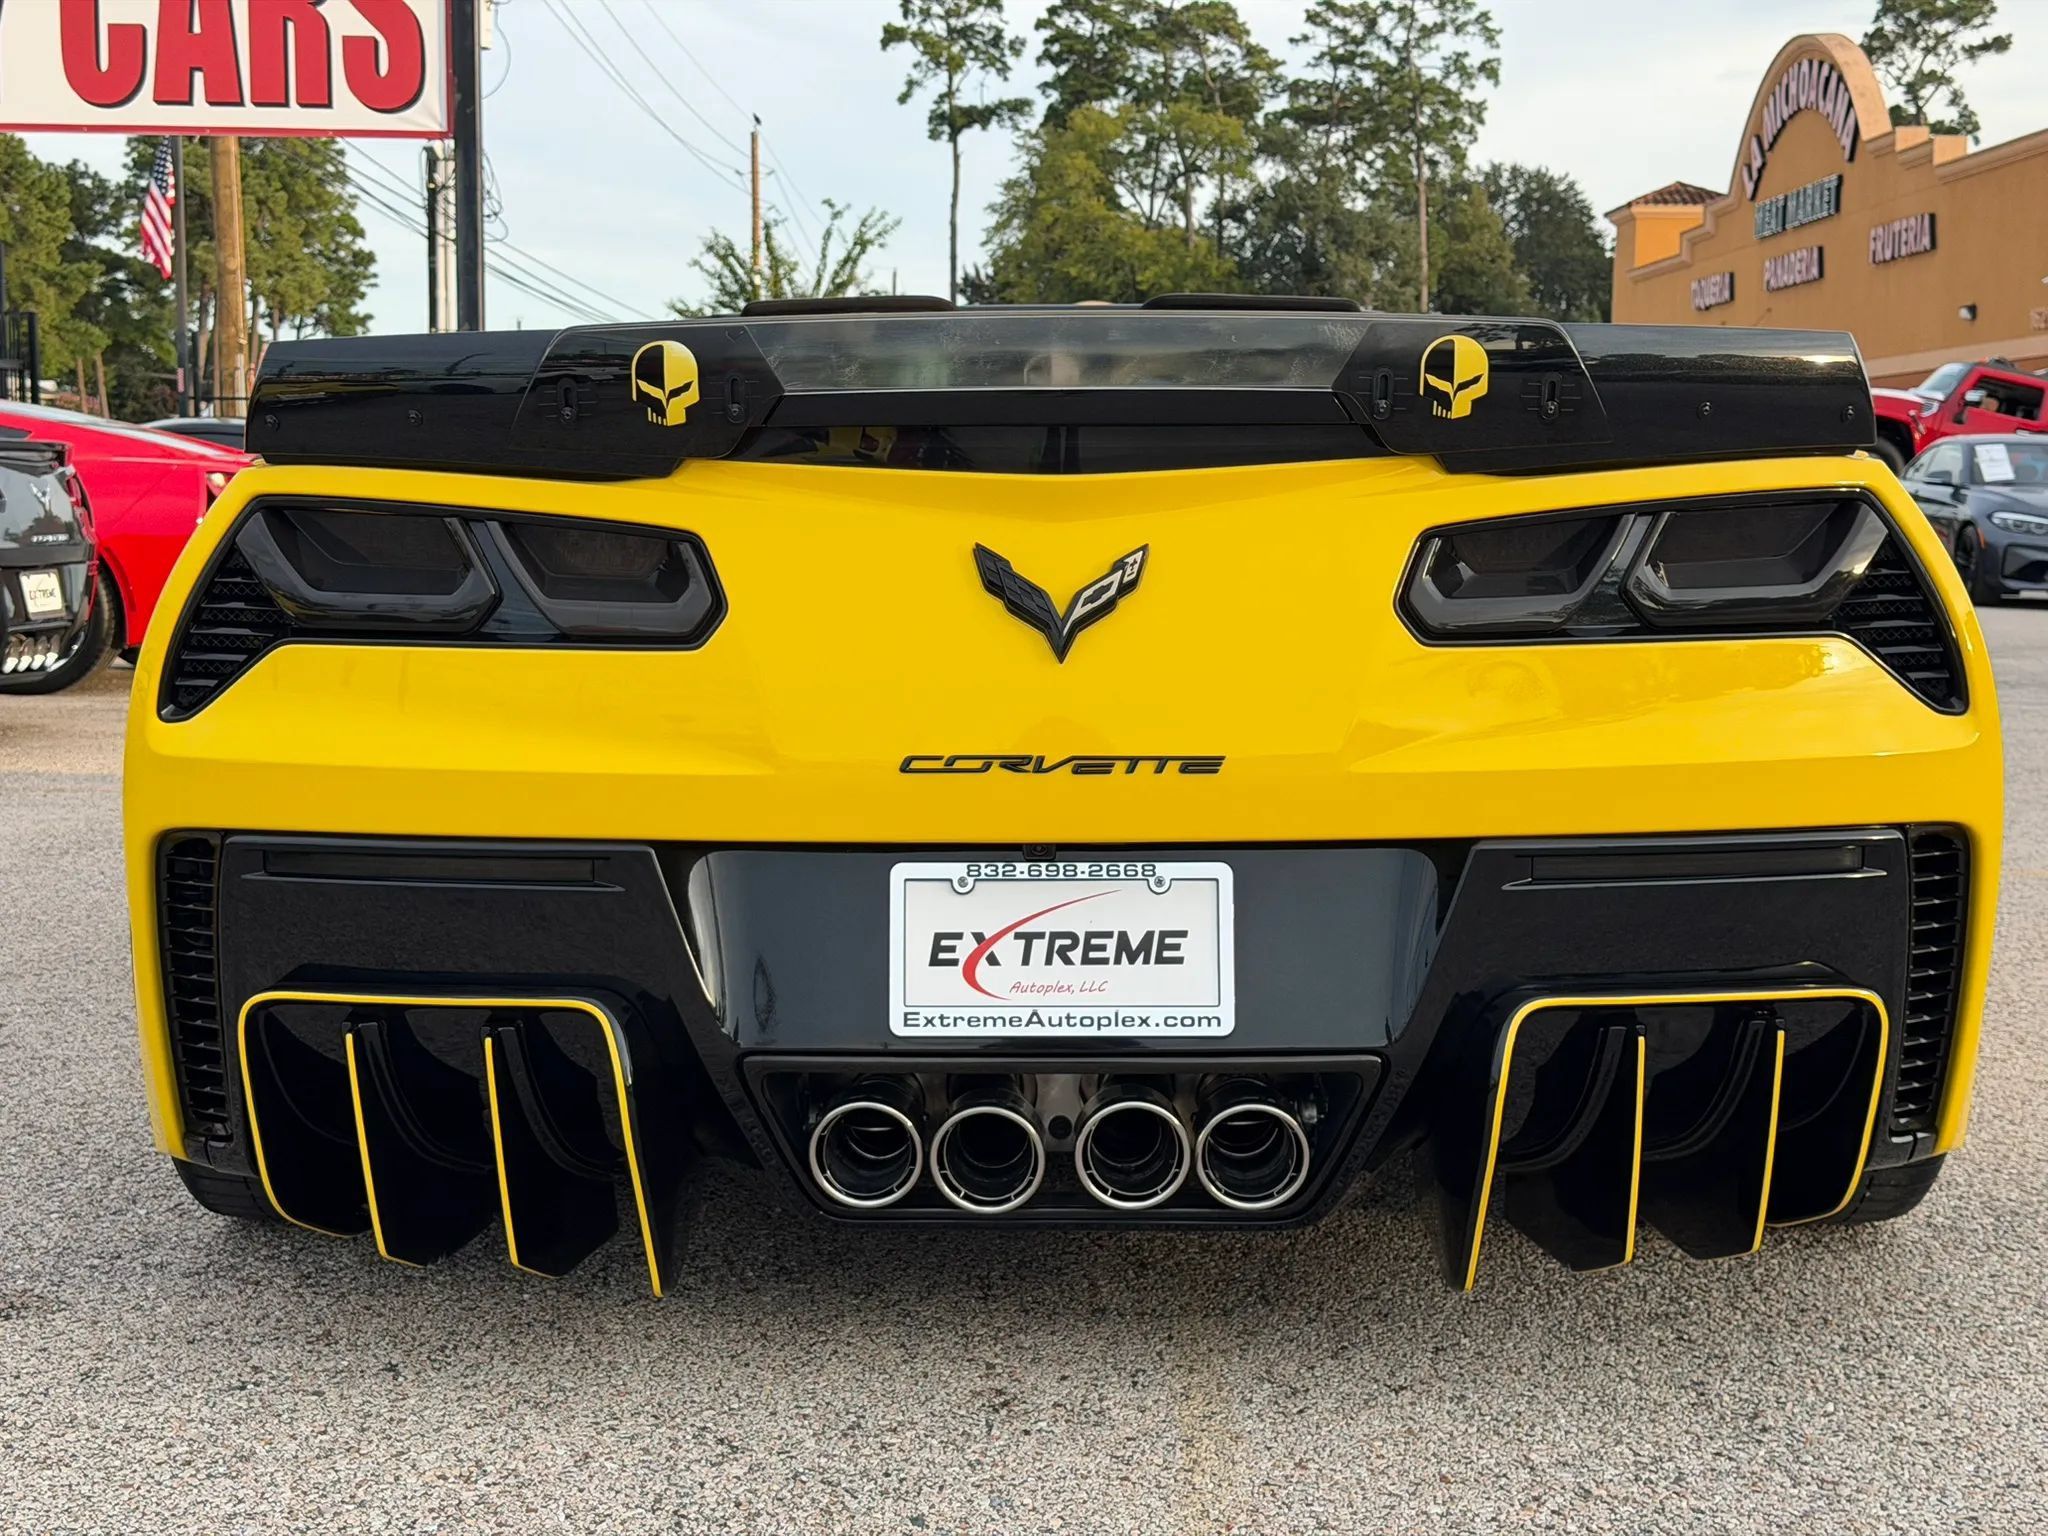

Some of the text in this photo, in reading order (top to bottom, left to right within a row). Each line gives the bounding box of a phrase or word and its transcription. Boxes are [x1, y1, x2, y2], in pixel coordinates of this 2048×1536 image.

[61, 0, 425, 113] CARS
[1742, 58, 1857, 201] LA MICHOACANA
[1754, 174, 1841, 239] MEAT MARKET
[1869, 213, 1933, 266] FRUTERIA
[1764, 246, 1821, 291] PANADERIA
[899, 755, 1226, 775] CORVETTE
[966, 864, 1157, 878] 832-698-2668
[928, 930, 1188, 967] EXTREME
[1009, 980, 1109, 997] Autoplex, LLC
[903, 1009, 1222, 1031] ExtremeAutoplex.com
